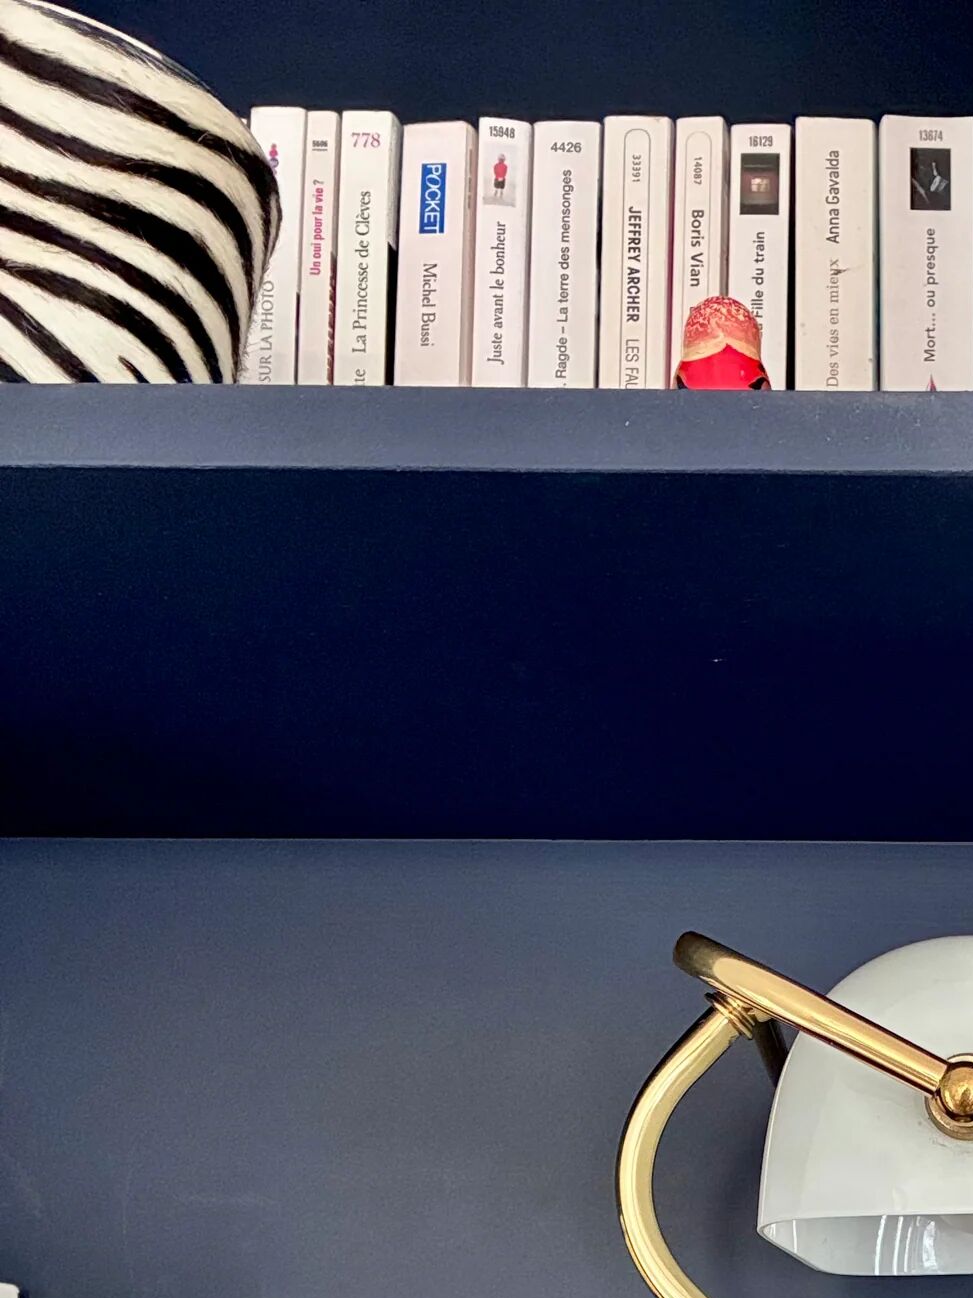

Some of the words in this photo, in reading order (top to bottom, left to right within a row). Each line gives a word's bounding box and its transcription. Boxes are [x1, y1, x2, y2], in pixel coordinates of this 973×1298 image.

[351, 132, 381, 148] 778
[489, 126, 515, 138] 15948
[749, 135, 773, 147] 16129
[551, 142, 582, 153] 4426
[631, 154, 641, 183] 33391
[693, 156, 703, 185] 14087
[825, 150, 840, 205] Gavalda
[312, 187, 324, 203] vie
[312, 204, 323, 215] la
[423, 164, 444, 232] POCKET
[560, 169, 573, 243] mensonges
[355, 191, 371, 236] Clèves
[690, 209, 704, 247] Boris
[826, 207, 840, 244] Anna
[313, 217, 325, 241] pour
[627, 206, 641, 262] JEFFREY
[310, 242, 321, 258] oui
[354, 241, 370, 258] de
[489, 221, 506, 275] bonheur
[558, 247, 569, 269] des
[752, 231, 765, 263] train
[926, 228, 938, 286] presque
[310, 259, 321, 276] Un
[689, 252, 704, 287] Vian
[751, 267, 764, 285] du
[826, 258, 841, 303] mieux
[352, 263, 369, 331] Princesse
[422, 263, 438, 308] Michel
[489, 279, 504, 290] le
[558, 273, 569, 303] terre
[626, 266, 640, 322] ARCHER
[926, 289, 936, 307] ou
[260, 280, 275, 331] PHOTO
[492, 294, 504, 329] avant
[557, 306, 568, 323] La
[751, 290, 764, 318] Fille
[829, 308, 840, 325] en
[260, 335, 273, 351] LA
[352, 333, 367, 353] La
[420, 314, 437, 347] Bussi
[487, 332, 504, 365] Juste
[555, 337, 570, 379] Ragde
[625, 339, 640, 362] LES
[258, 355, 272, 383] SUR
[354, 368, 366, 386] te
